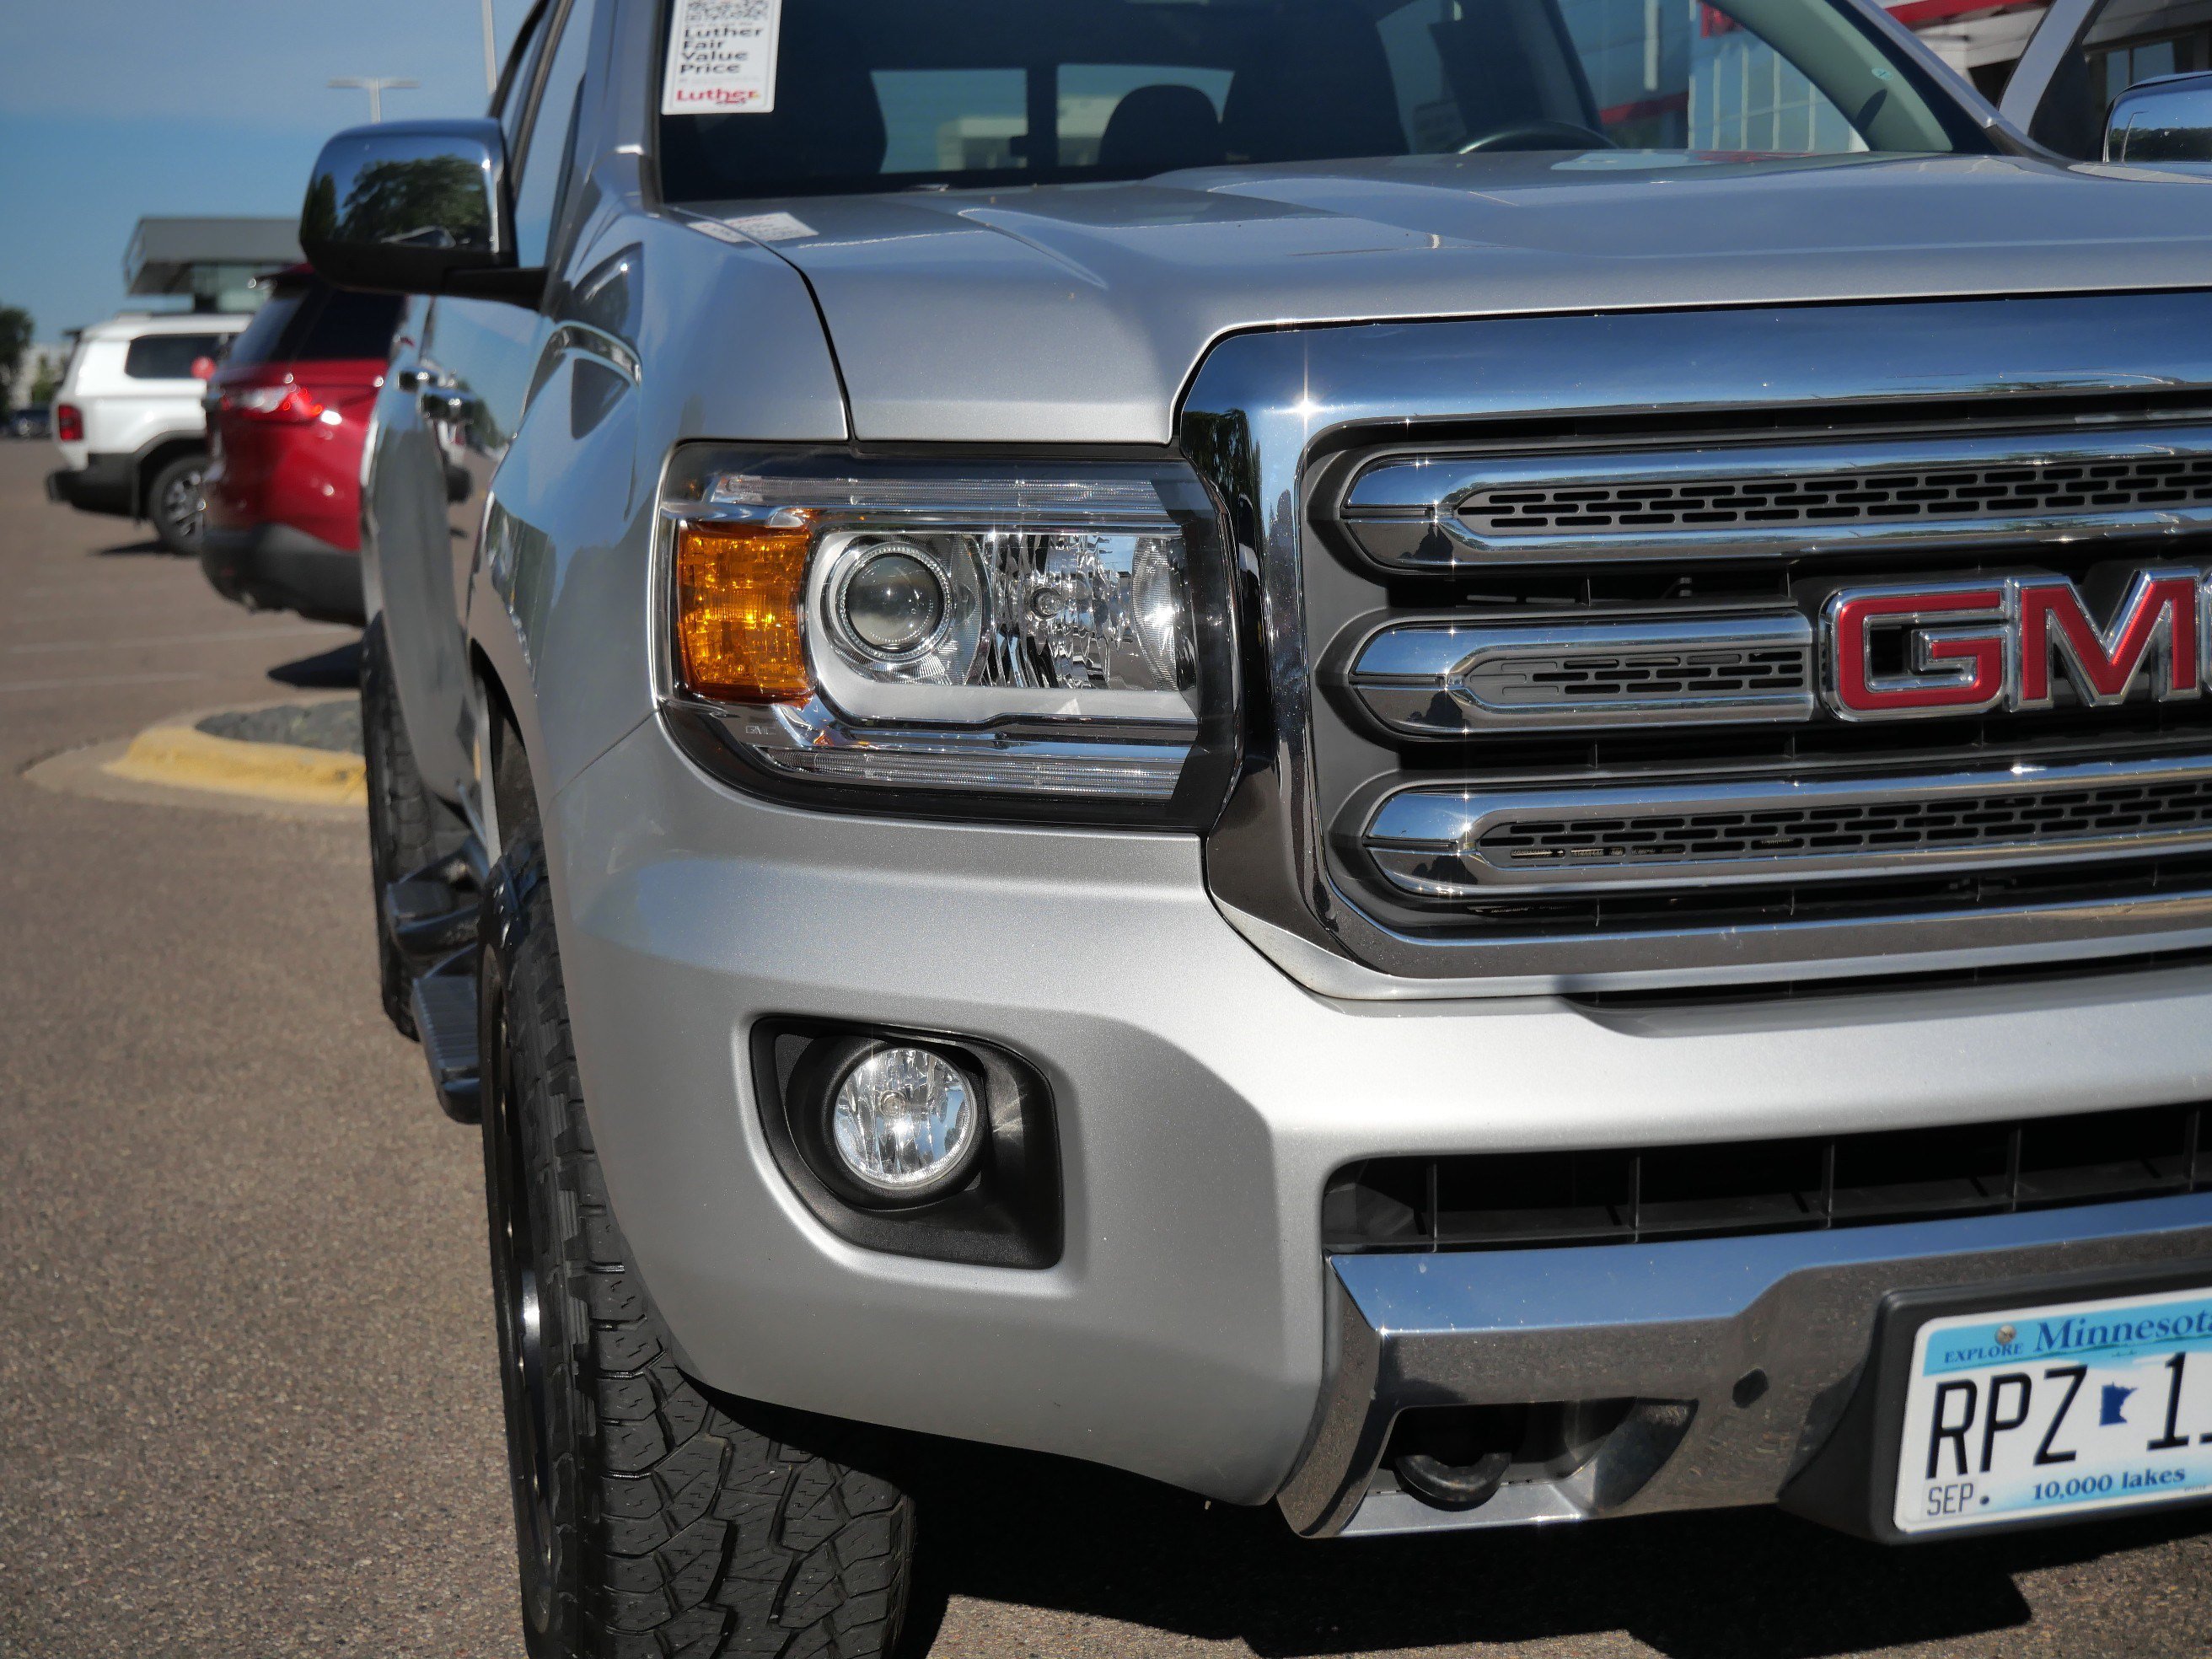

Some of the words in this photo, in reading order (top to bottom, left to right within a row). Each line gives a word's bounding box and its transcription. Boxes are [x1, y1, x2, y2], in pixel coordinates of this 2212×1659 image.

[683, 40, 725, 50] Fair
[685, 27, 763, 38] Luther
[680, 62, 740, 74] Price
[682, 51, 749, 61] Value
[1819, 567, 2212, 722] GM
[1943, 1342, 2024, 1364] EXPLORE
[2034, 1309, 2212, 1352] Minnesot
[1925, 1363, 2088, 1479] RPZ
[2146, 1351, 2212, 1452] 1
[1926, 1482, 1974, 1516] SEP
[2031, 1474, 2113, 1501] 10,000
[2121, 1468, 2186, 1490] lakes
